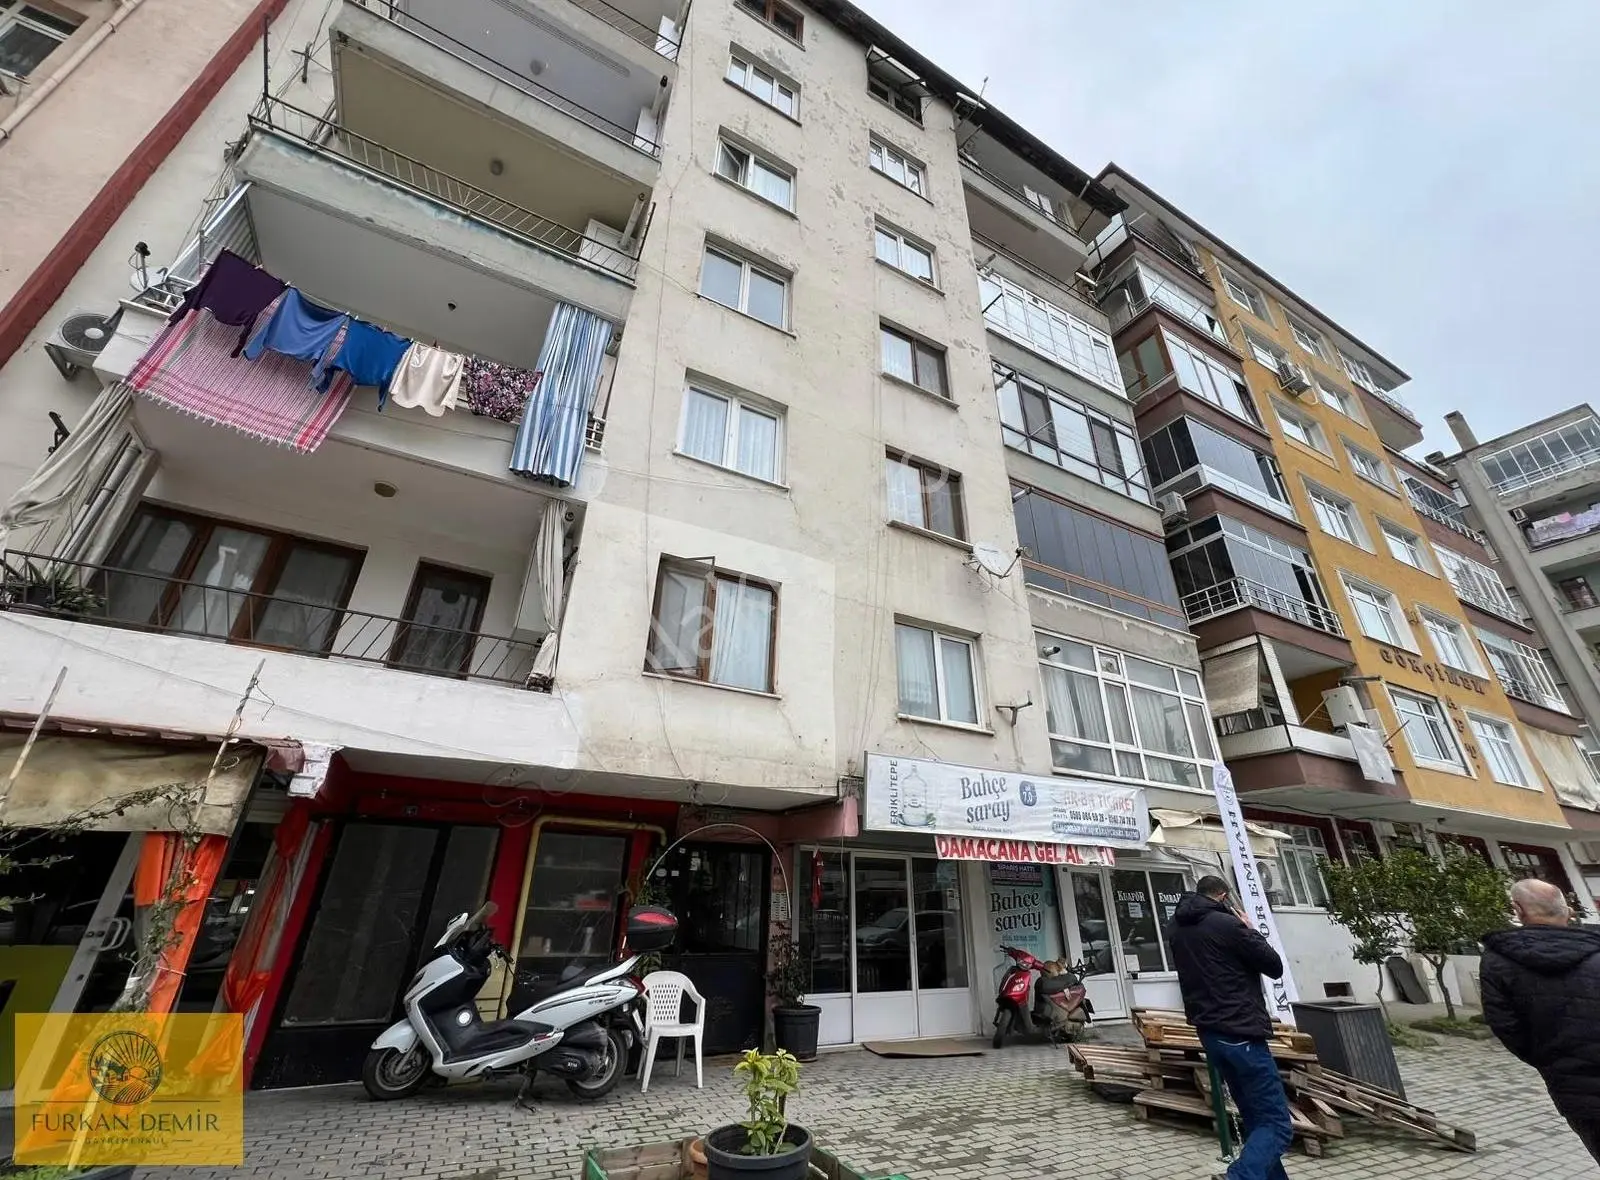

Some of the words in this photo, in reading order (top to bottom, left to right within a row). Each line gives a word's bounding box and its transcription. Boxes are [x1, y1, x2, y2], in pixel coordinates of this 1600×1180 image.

[960, 773, 1008, 803] Bahçe
[966, 801, 1011, 824] saray
[938, 837, 1033, 862] DAMACANA
[1036, 842, 1063, 863] GEL
[990, 888, 1040, 913] Bahçe
[995, 908, 1042, 932] saray
